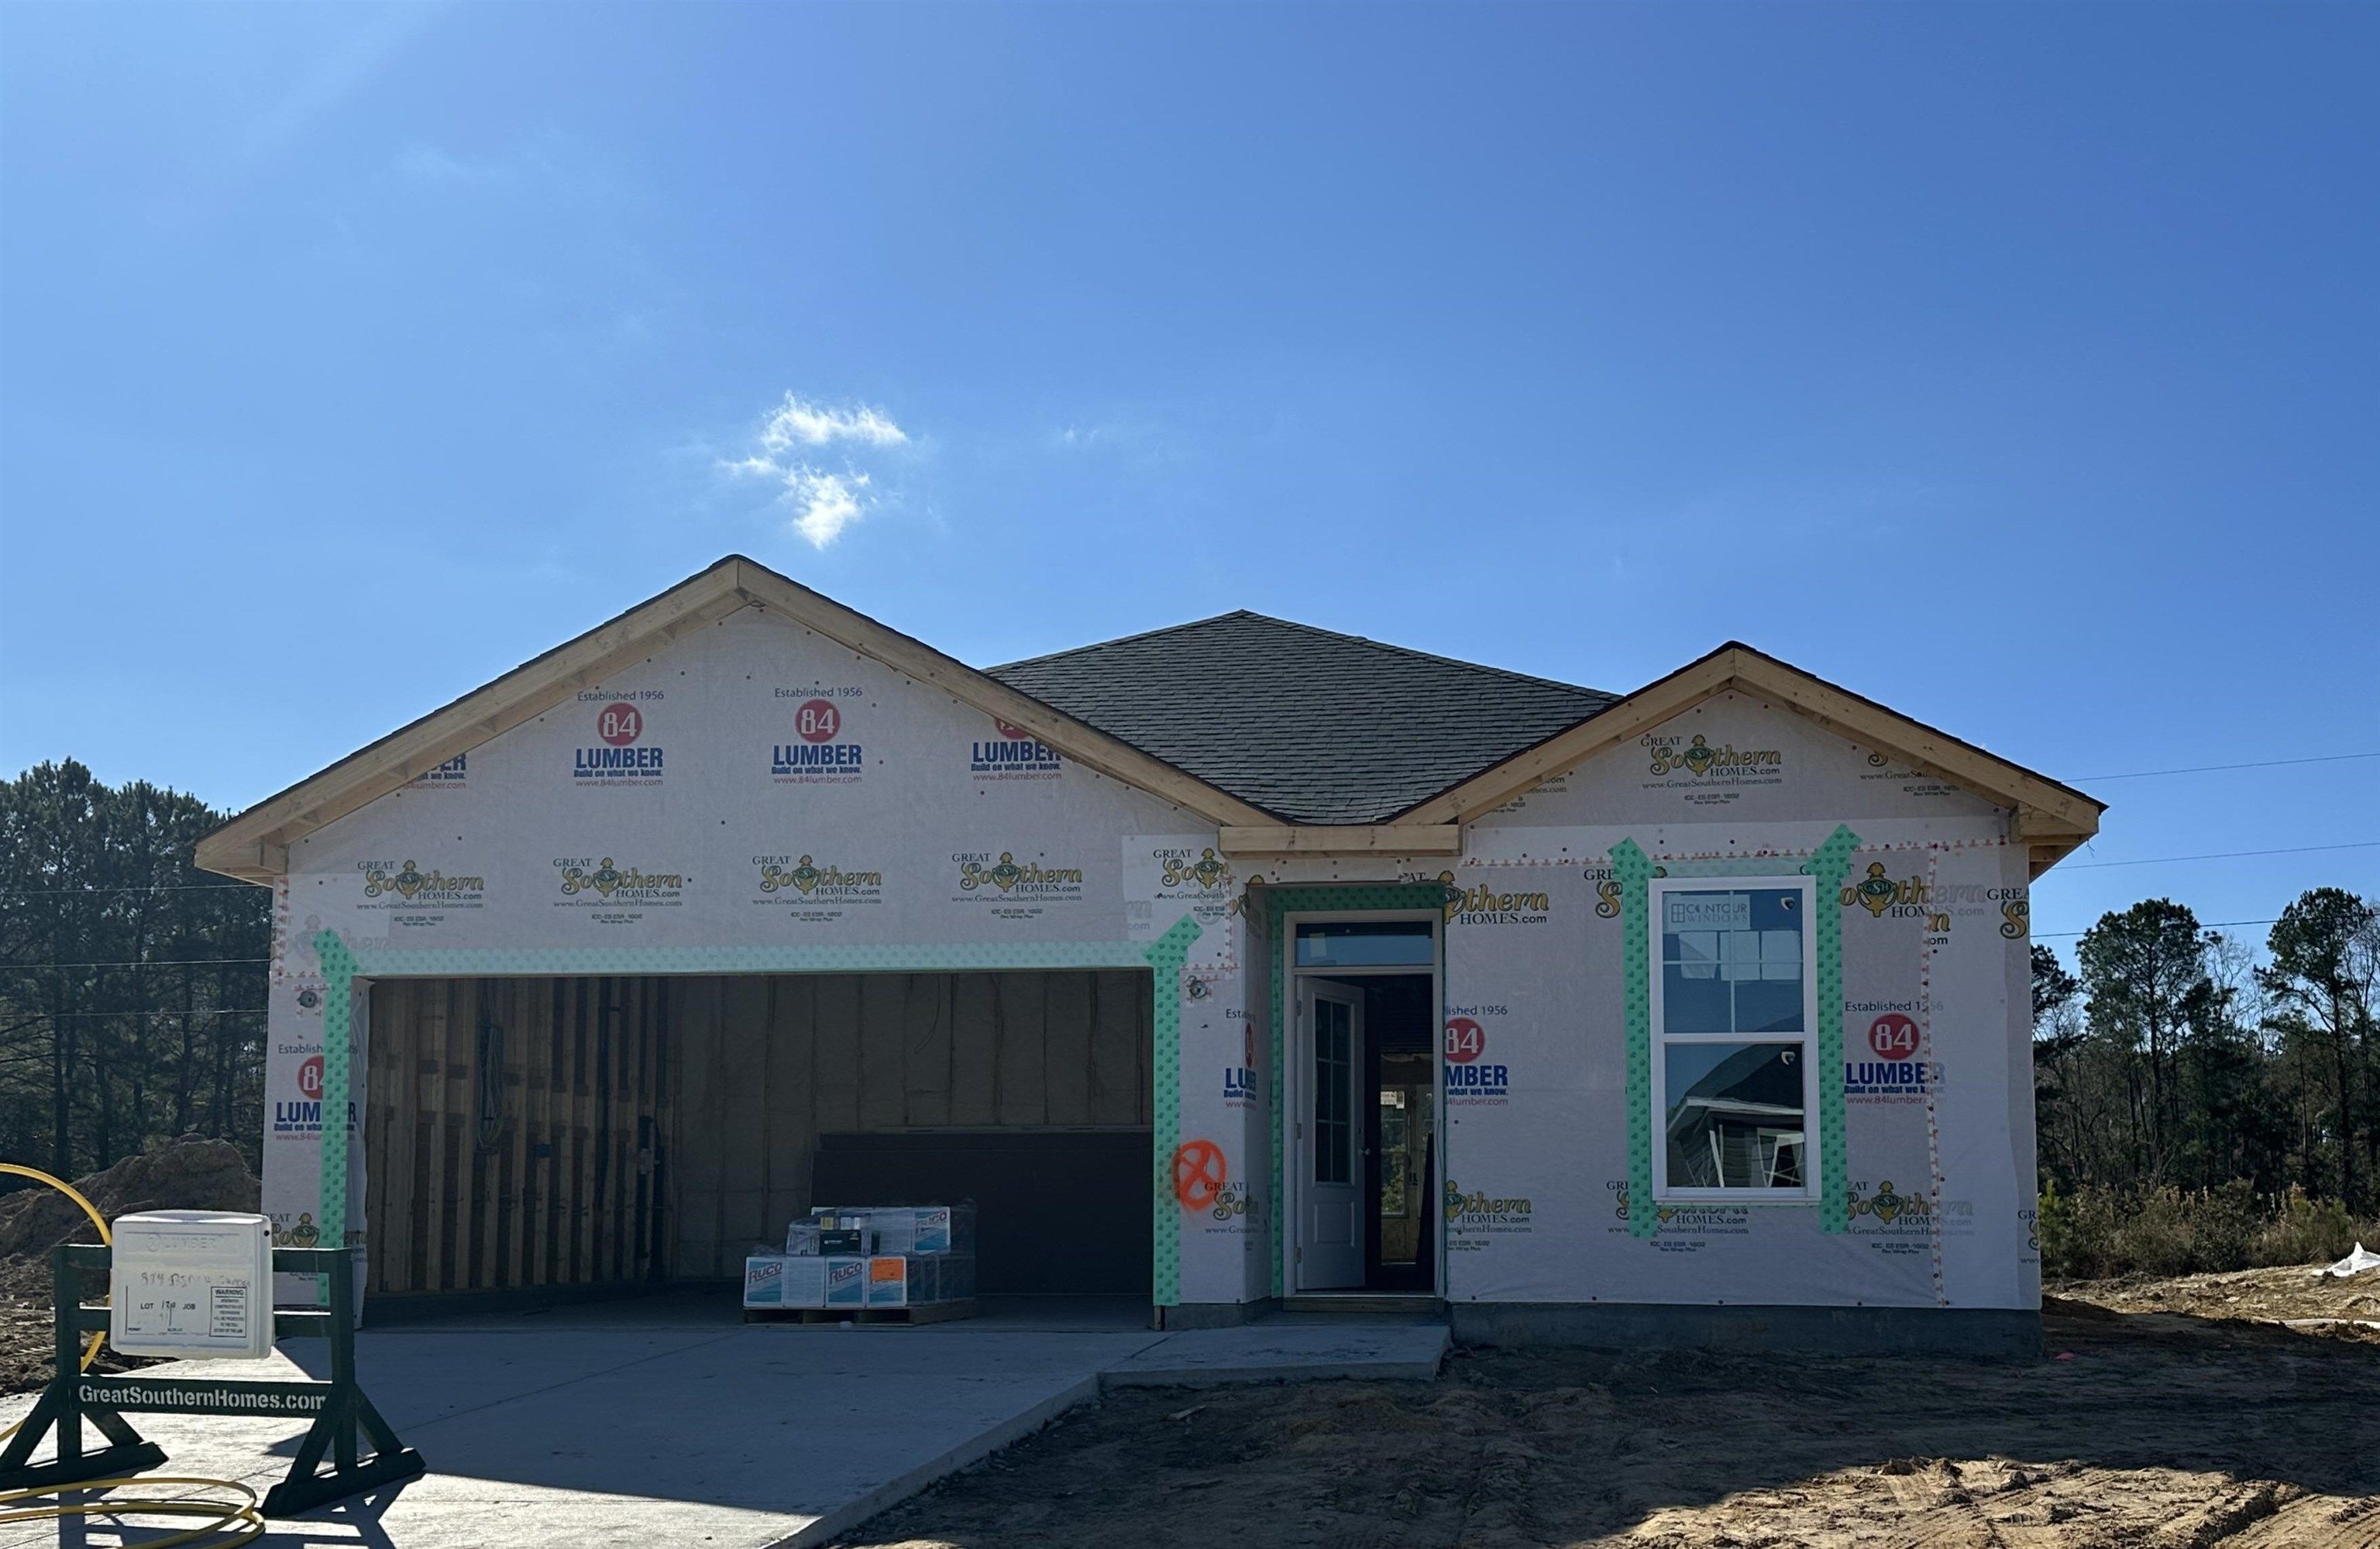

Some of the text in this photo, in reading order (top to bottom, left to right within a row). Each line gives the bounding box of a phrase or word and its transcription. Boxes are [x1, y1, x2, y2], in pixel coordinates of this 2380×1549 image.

[577, 690, 664, 701] Established 1956
[775, 687, 862, 697] Established 1956
[603, 712, 636, 737] 84
[801, 708, 834, 734] 84
[1640, 736, 1683, 748] GREAT
[576, 748, 663, 768] LUMBER
[773, 745, 862, 766] LUMBER
[773, 776, 862, 784] www.84lumber.com
[973, 773, 1061, 781] www.84lumber.com
[576, 778, 663, 787] www.84lumber.com
[952, 853, 991, 862] GREAT
[1154, 849, 1192, 859] GREAT
[552, 858, 592, 867] GREAT
[752, 855, 791, 865] GREAT
[357, 861, 394, 870] GREAT
[1460, 913, 1546, 924] HOMES.com
[1482, 1006, 1508, 1015] 1956
[1845, 1001, 1911, 1012] Established
[1446, 1028, 1479, 1054] 84
[1875, 1024, 1914, 1051] 84
[1446, 1065, 1508, 1086] MBER
[1844, 1085, 1866, 1094] Build
[1204, 1182, 1245, 1191] GREAT
[1462, 1214, 1530, 1224] HOMES.com
[1676, 1215, 1747, 1224] HOMES.com
[749, 1262, 782, 1286] RUCO
[829, 1262, 862, 1285] RUCO
[78, 1384, 326, 1410] GreatSouthernHomes.com
